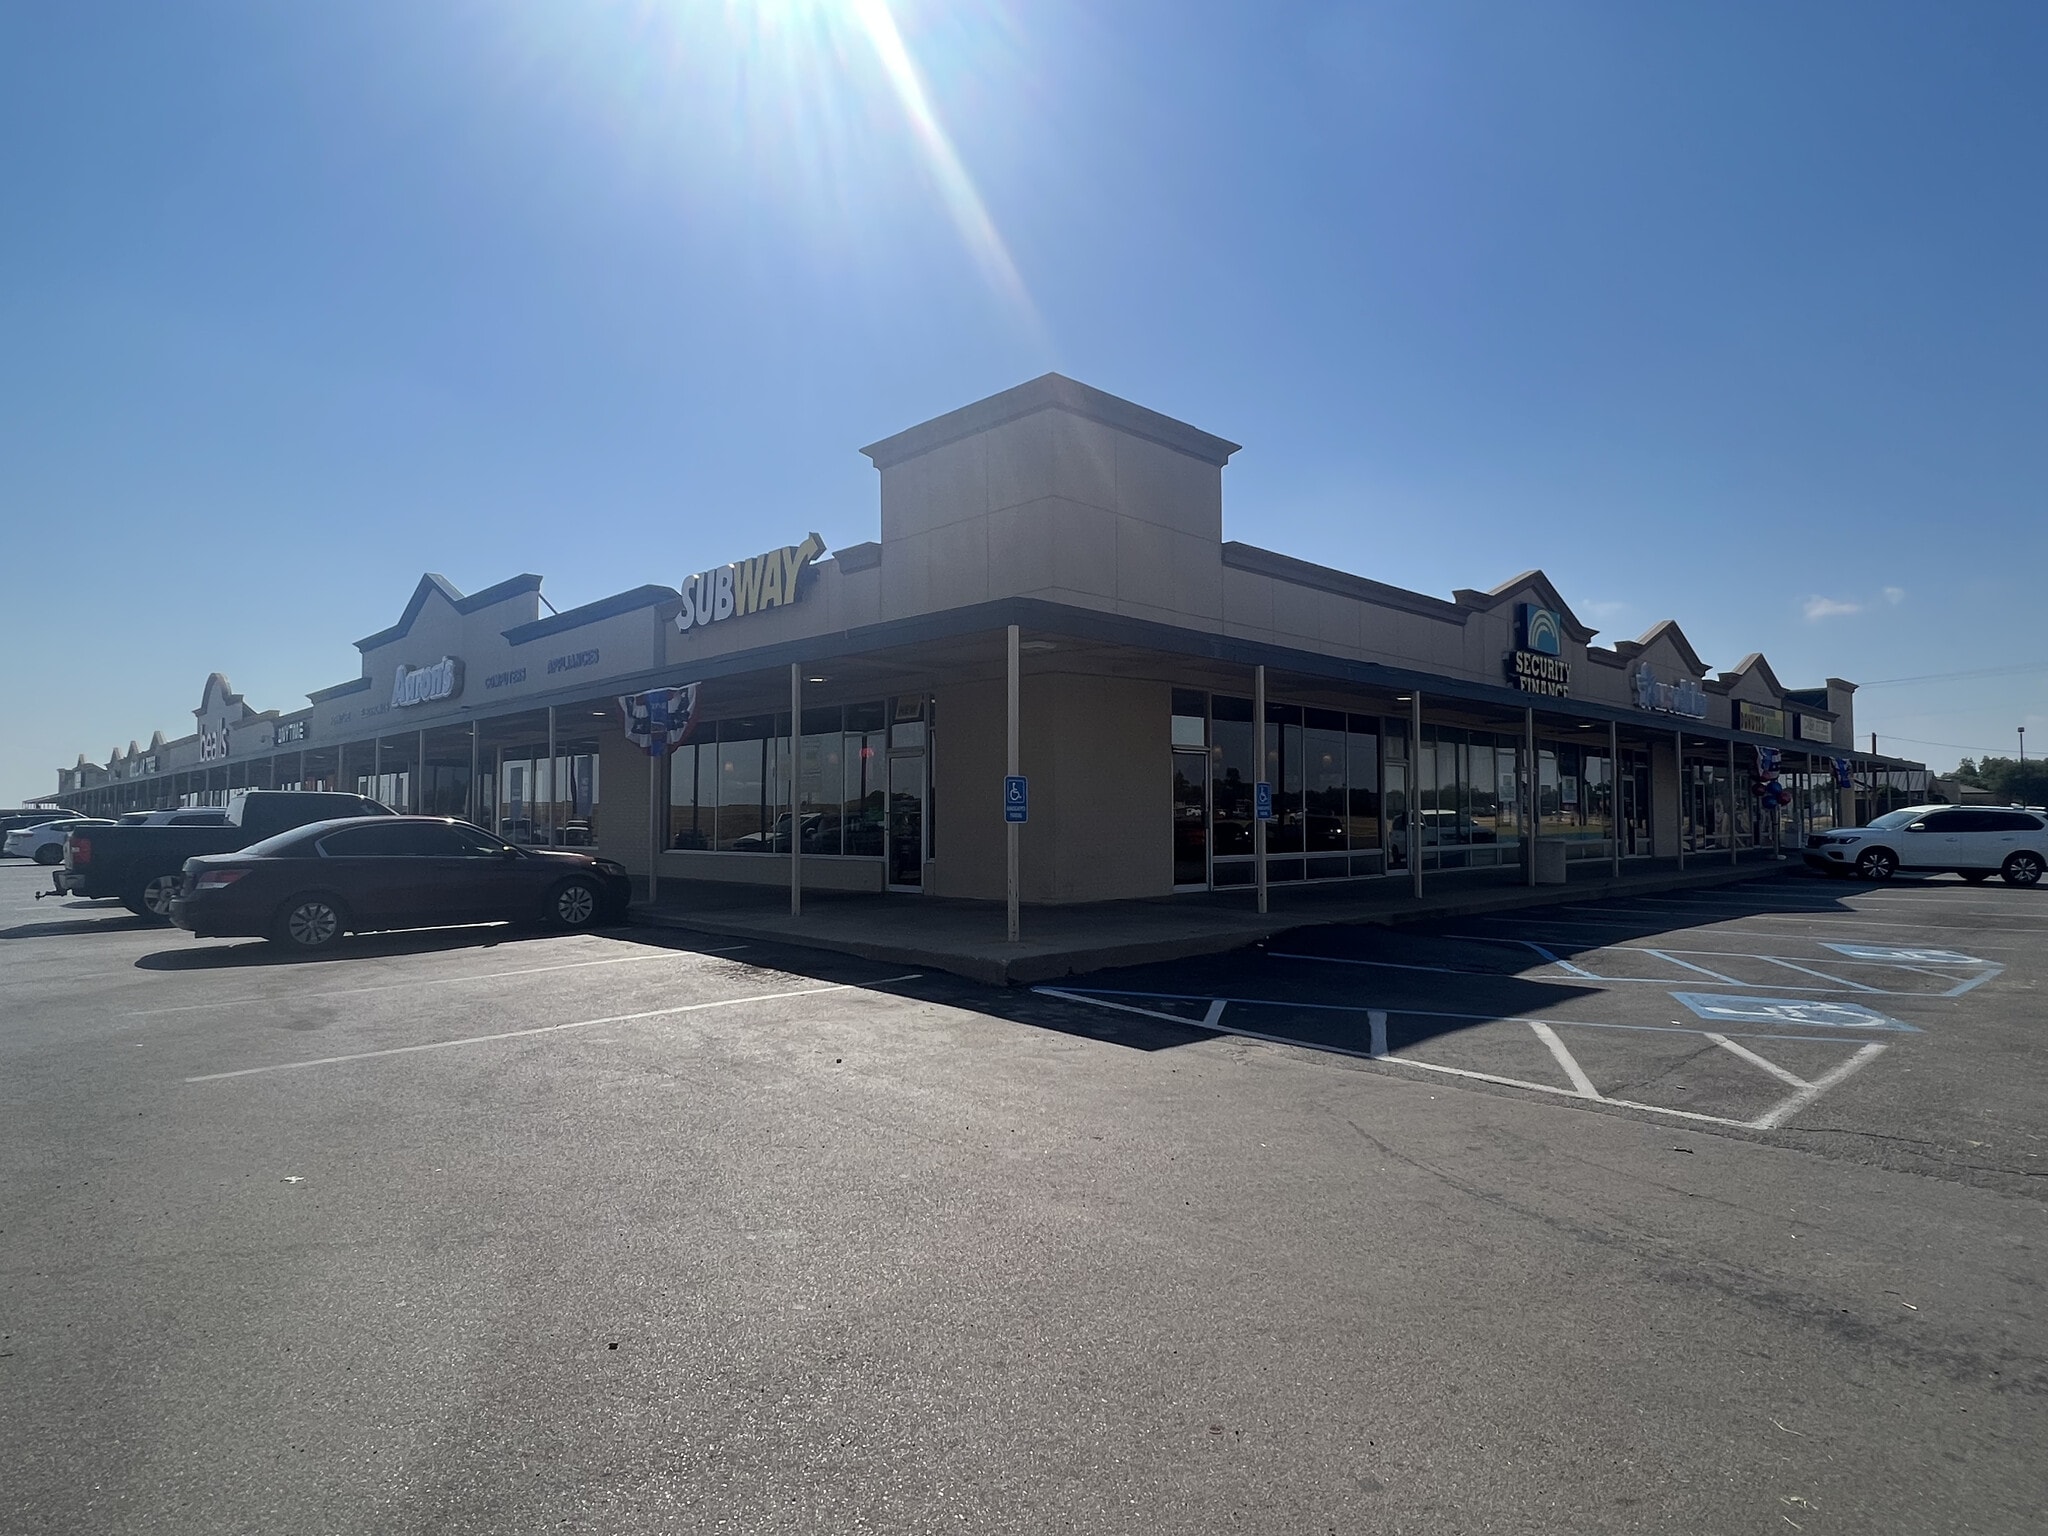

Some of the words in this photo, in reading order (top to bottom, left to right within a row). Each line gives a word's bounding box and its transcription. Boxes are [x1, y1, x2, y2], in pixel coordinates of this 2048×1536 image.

[675, 534, 824, 631] SUBWAY
[391, 656, 456, 707] Aaron's
[547, 648, 599, 674] APPLIANCES
[1516, 651, 1571, 683] SECURITY
